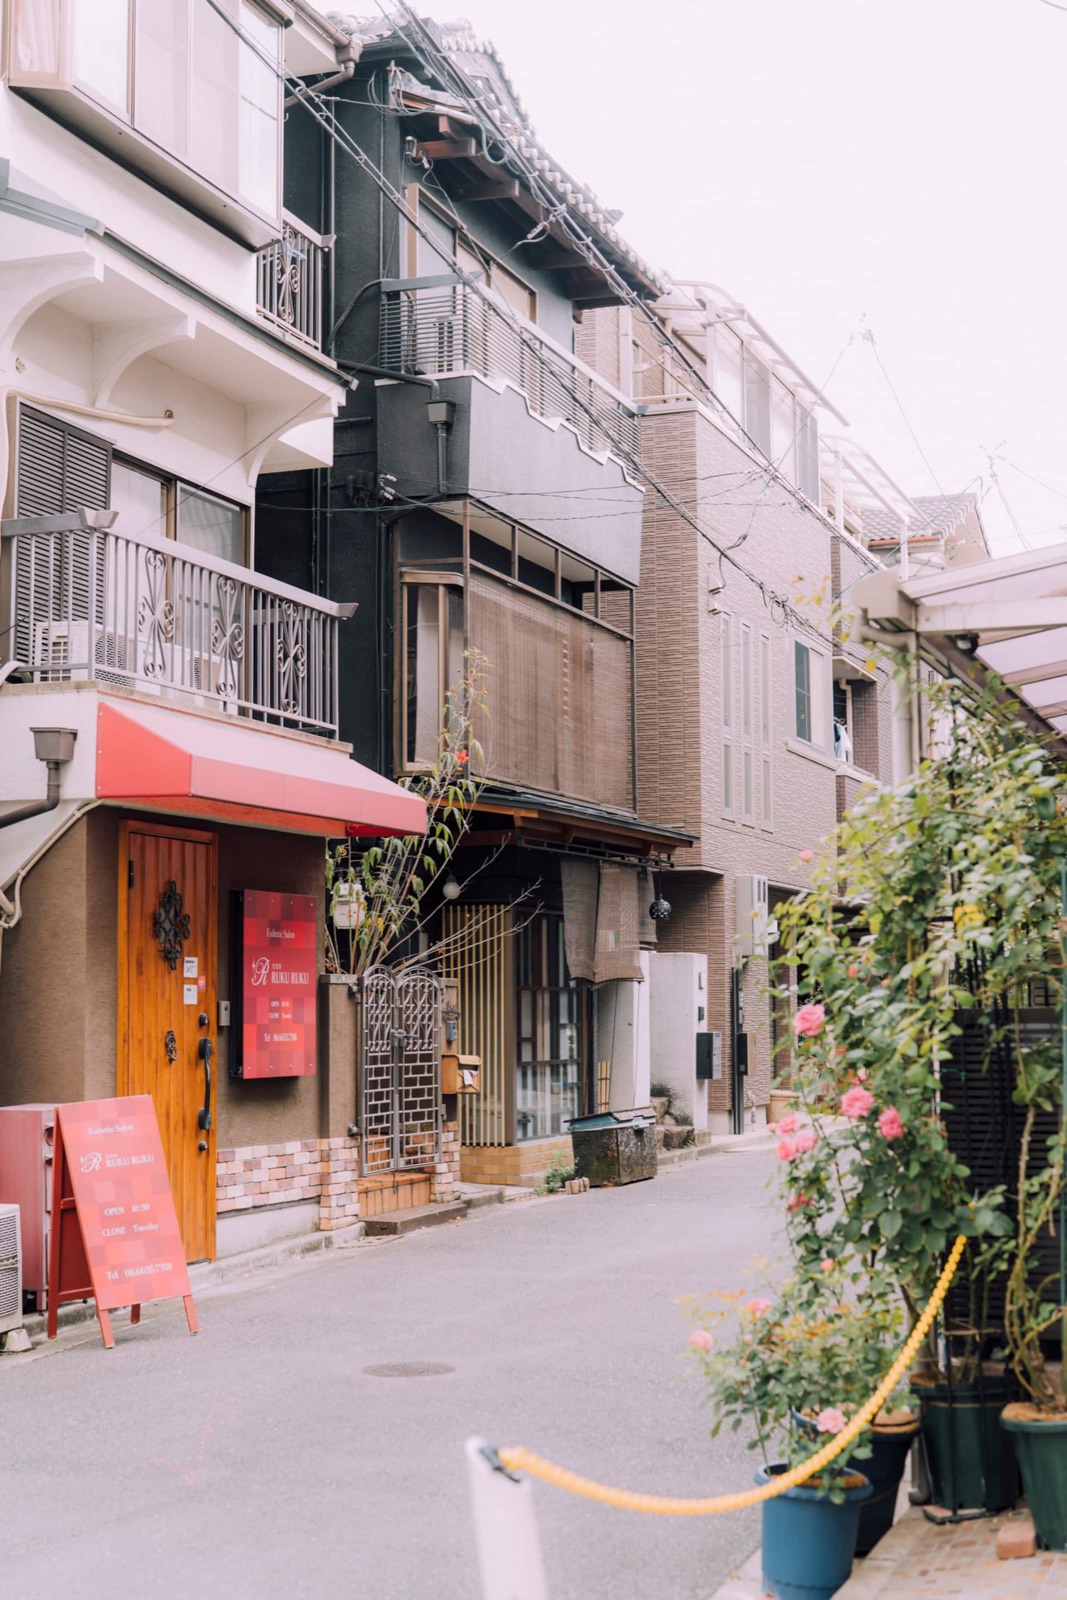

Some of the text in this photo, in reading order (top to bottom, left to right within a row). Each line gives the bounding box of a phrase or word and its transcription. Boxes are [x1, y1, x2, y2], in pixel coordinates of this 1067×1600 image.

[271, 971, 309, 984] RUKU RUKU
[115, 1124, 134, 1133] Salon
[106, 1158, 130, 1168] RUKU
[131, 1153, 155, 1165] RUKU
[104, 1207, 124, 1216] OPEN
[102, 1223, 158, 1237] CLOSE Tuesday
[106, 1271, 119, 1280] Tel
